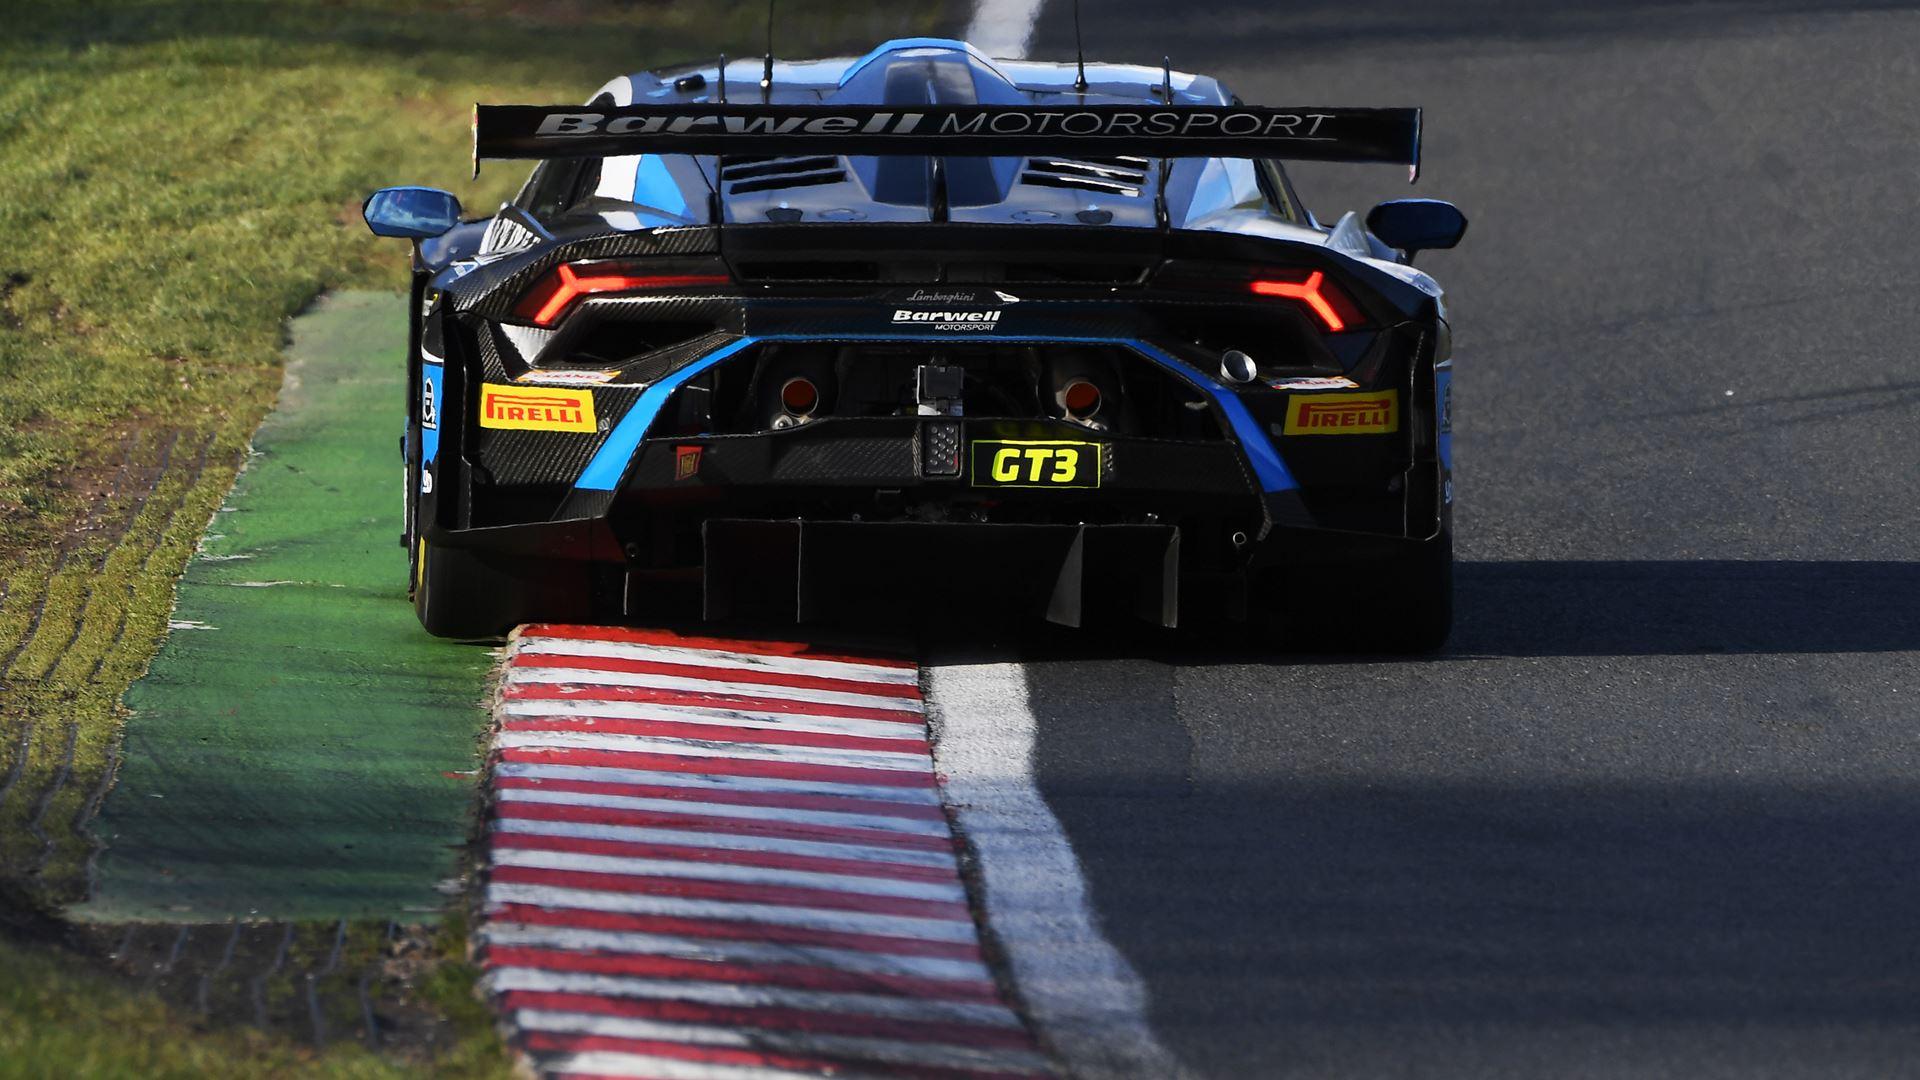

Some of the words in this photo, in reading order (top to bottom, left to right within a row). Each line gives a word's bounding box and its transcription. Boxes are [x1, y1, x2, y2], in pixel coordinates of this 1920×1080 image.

[536, 112, 925, 136] Barwell
[939, 110, 1336, 137] MOTORSPORT
[907, 290, 976, 303] Lamborghini
[893, 310, 1001, 322] Barwell
[487, 394, 582, 424] PIRELLI
[1297, 400, 1391, 427] PIRELLI
[991, 448, 1079, 482] GT3
